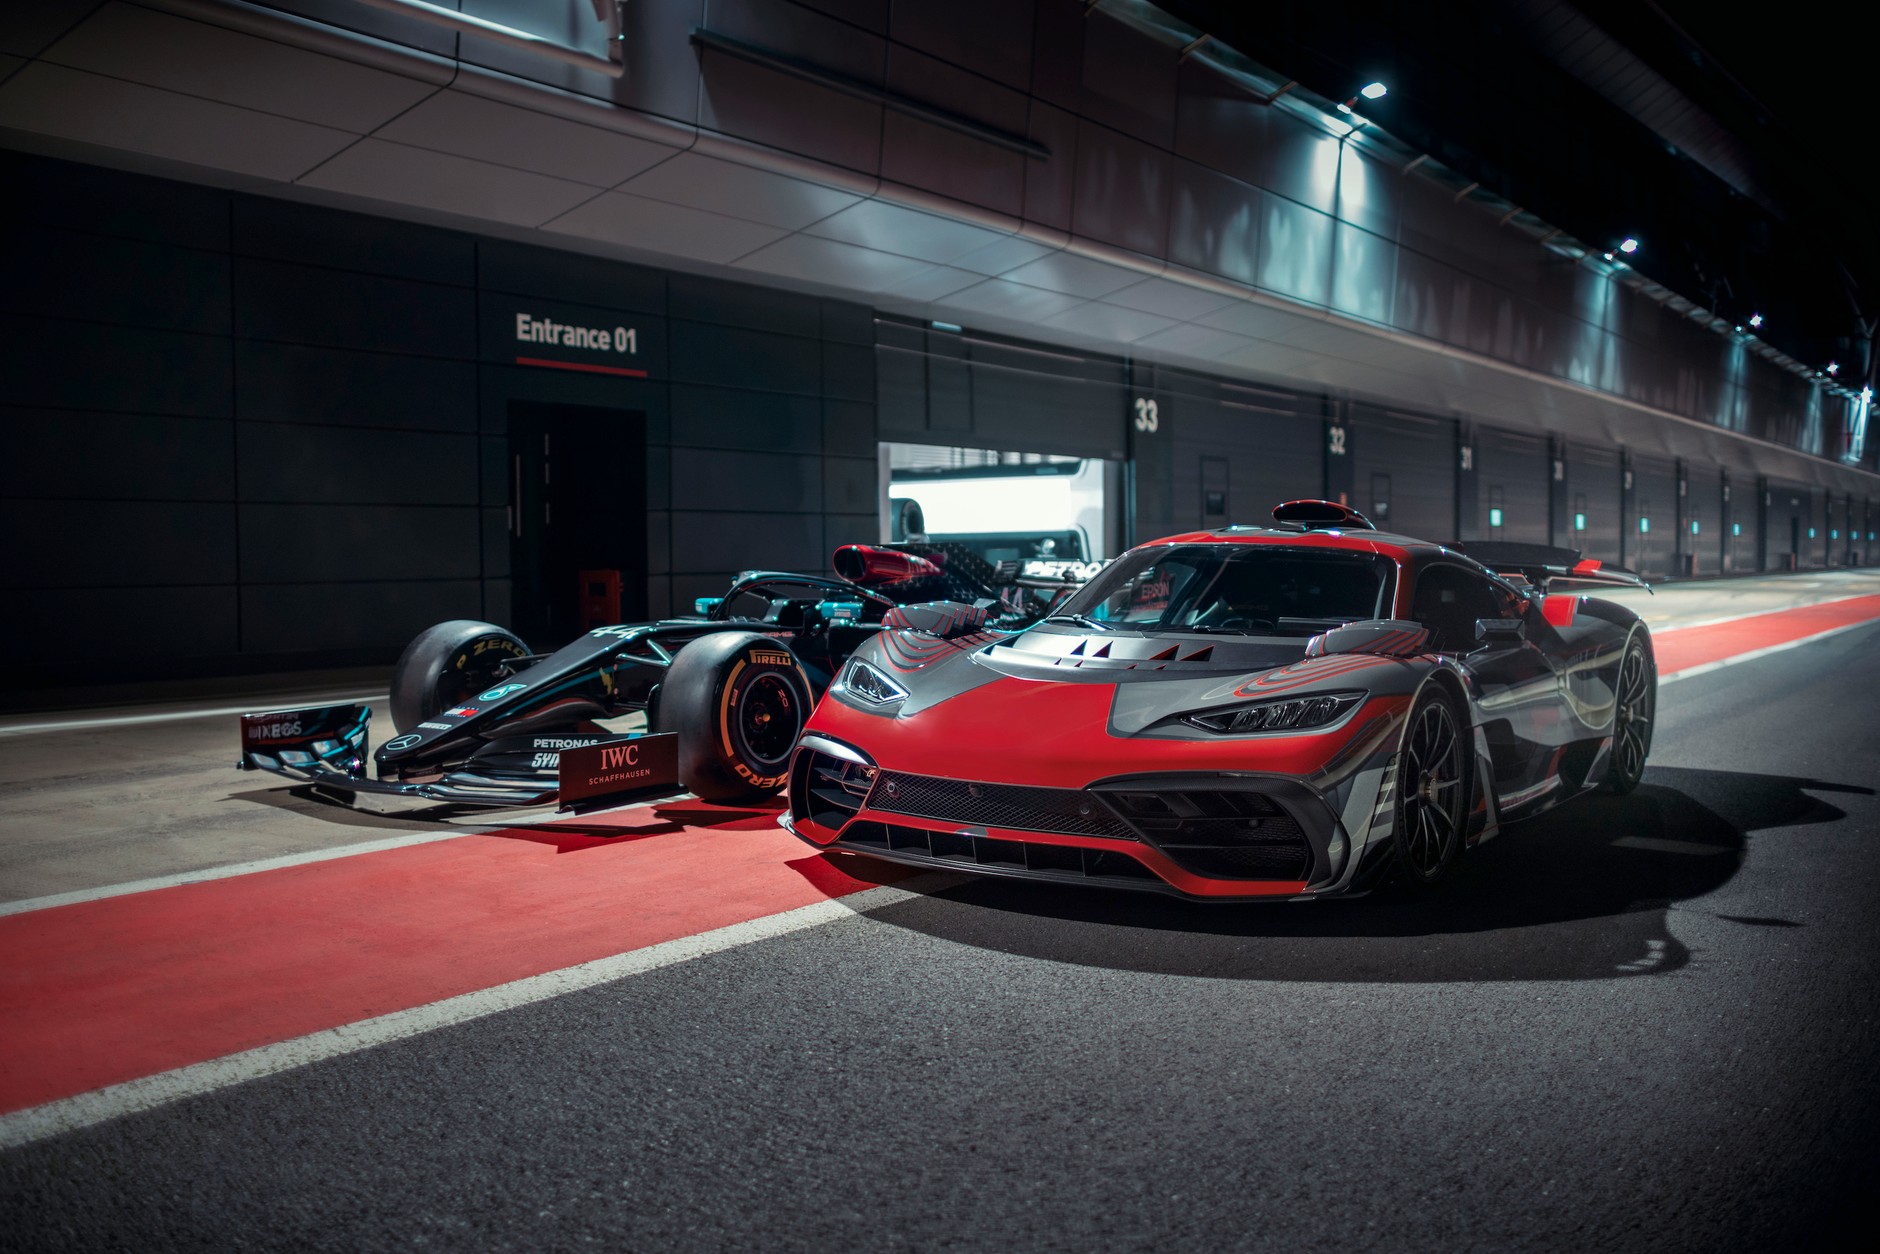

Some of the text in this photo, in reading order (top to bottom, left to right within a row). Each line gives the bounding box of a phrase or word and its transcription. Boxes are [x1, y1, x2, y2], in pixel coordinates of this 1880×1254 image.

[516, 312, 637, 355] Entrance 01
[1134, 397, 1159, 433] 33
[1328, 426, 1346, 455] 32
[1025, 560, 1111, 579] PETRO
[473, 639, 526, 657] ZERO
[749, 649, 792, 666] PIRELLI
[533, 738, 598, 749] PETRONAS
[531, 752, 560, 768] SYN
[601, 744, 639, 770] IWC
[588, 768, 651, 786] SCHAFFHAUSEN
